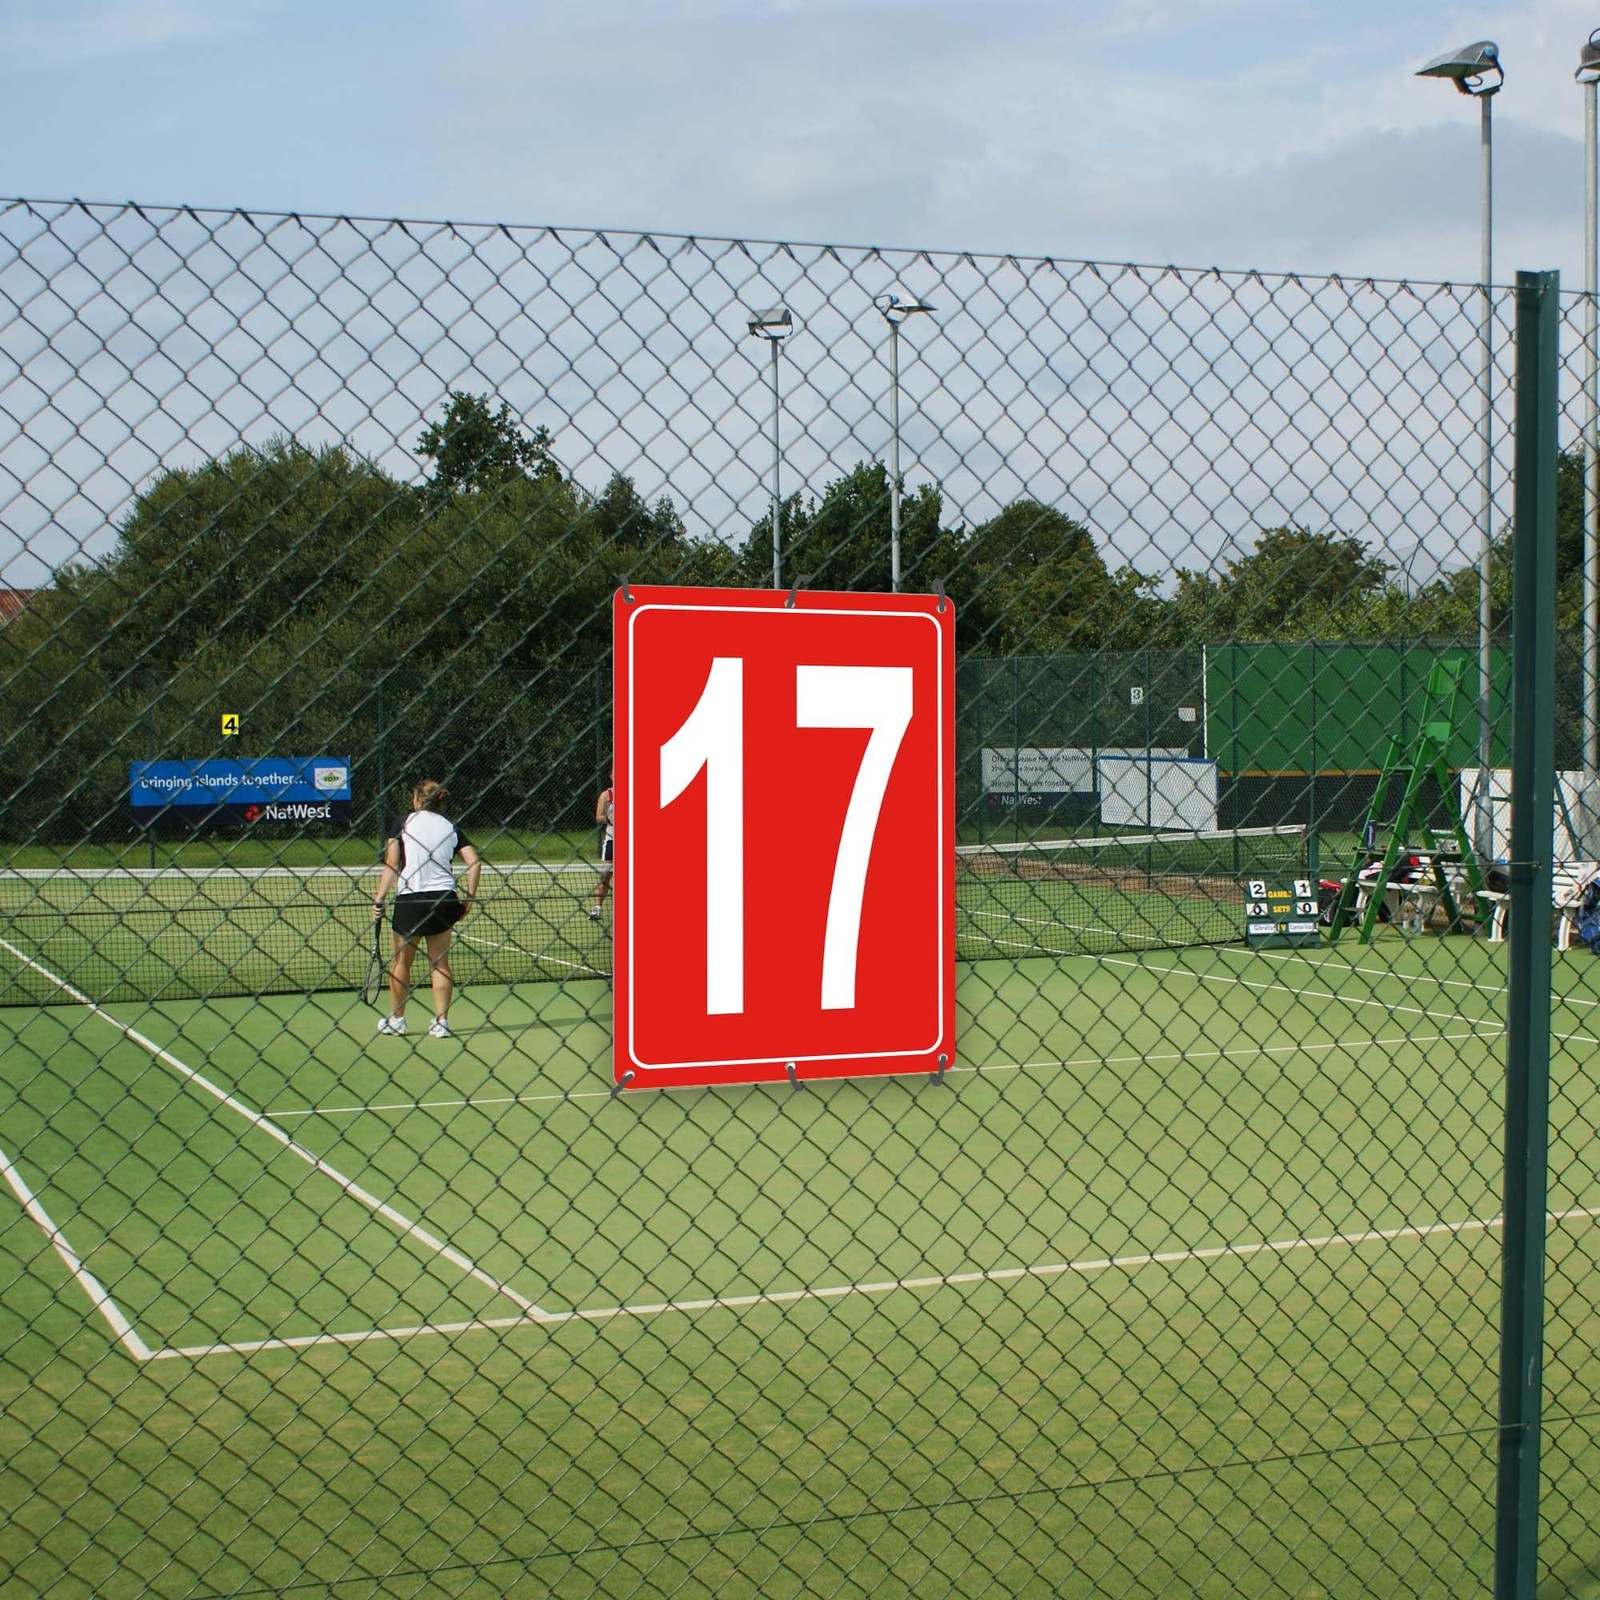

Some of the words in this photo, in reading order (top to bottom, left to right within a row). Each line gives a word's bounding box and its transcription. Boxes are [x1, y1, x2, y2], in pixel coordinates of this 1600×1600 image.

[1133, 688, 1141, 700] 3
[224, 717, 238, 732] 4
[195, 774, 239, 787] islands
[1001, 795, 1042, 805] NaWest
[265, 804, 332, 820] NatWest
[660, 657, 913, 1015] 17
[1253, 884, 1264, 895] 2
[1300, 883, 1307, 893] 1
[1253, 902, 1263, 915] 0
[1273, 905, 1291, 913] SETS
[1303, 902, 1312, 913] 0
